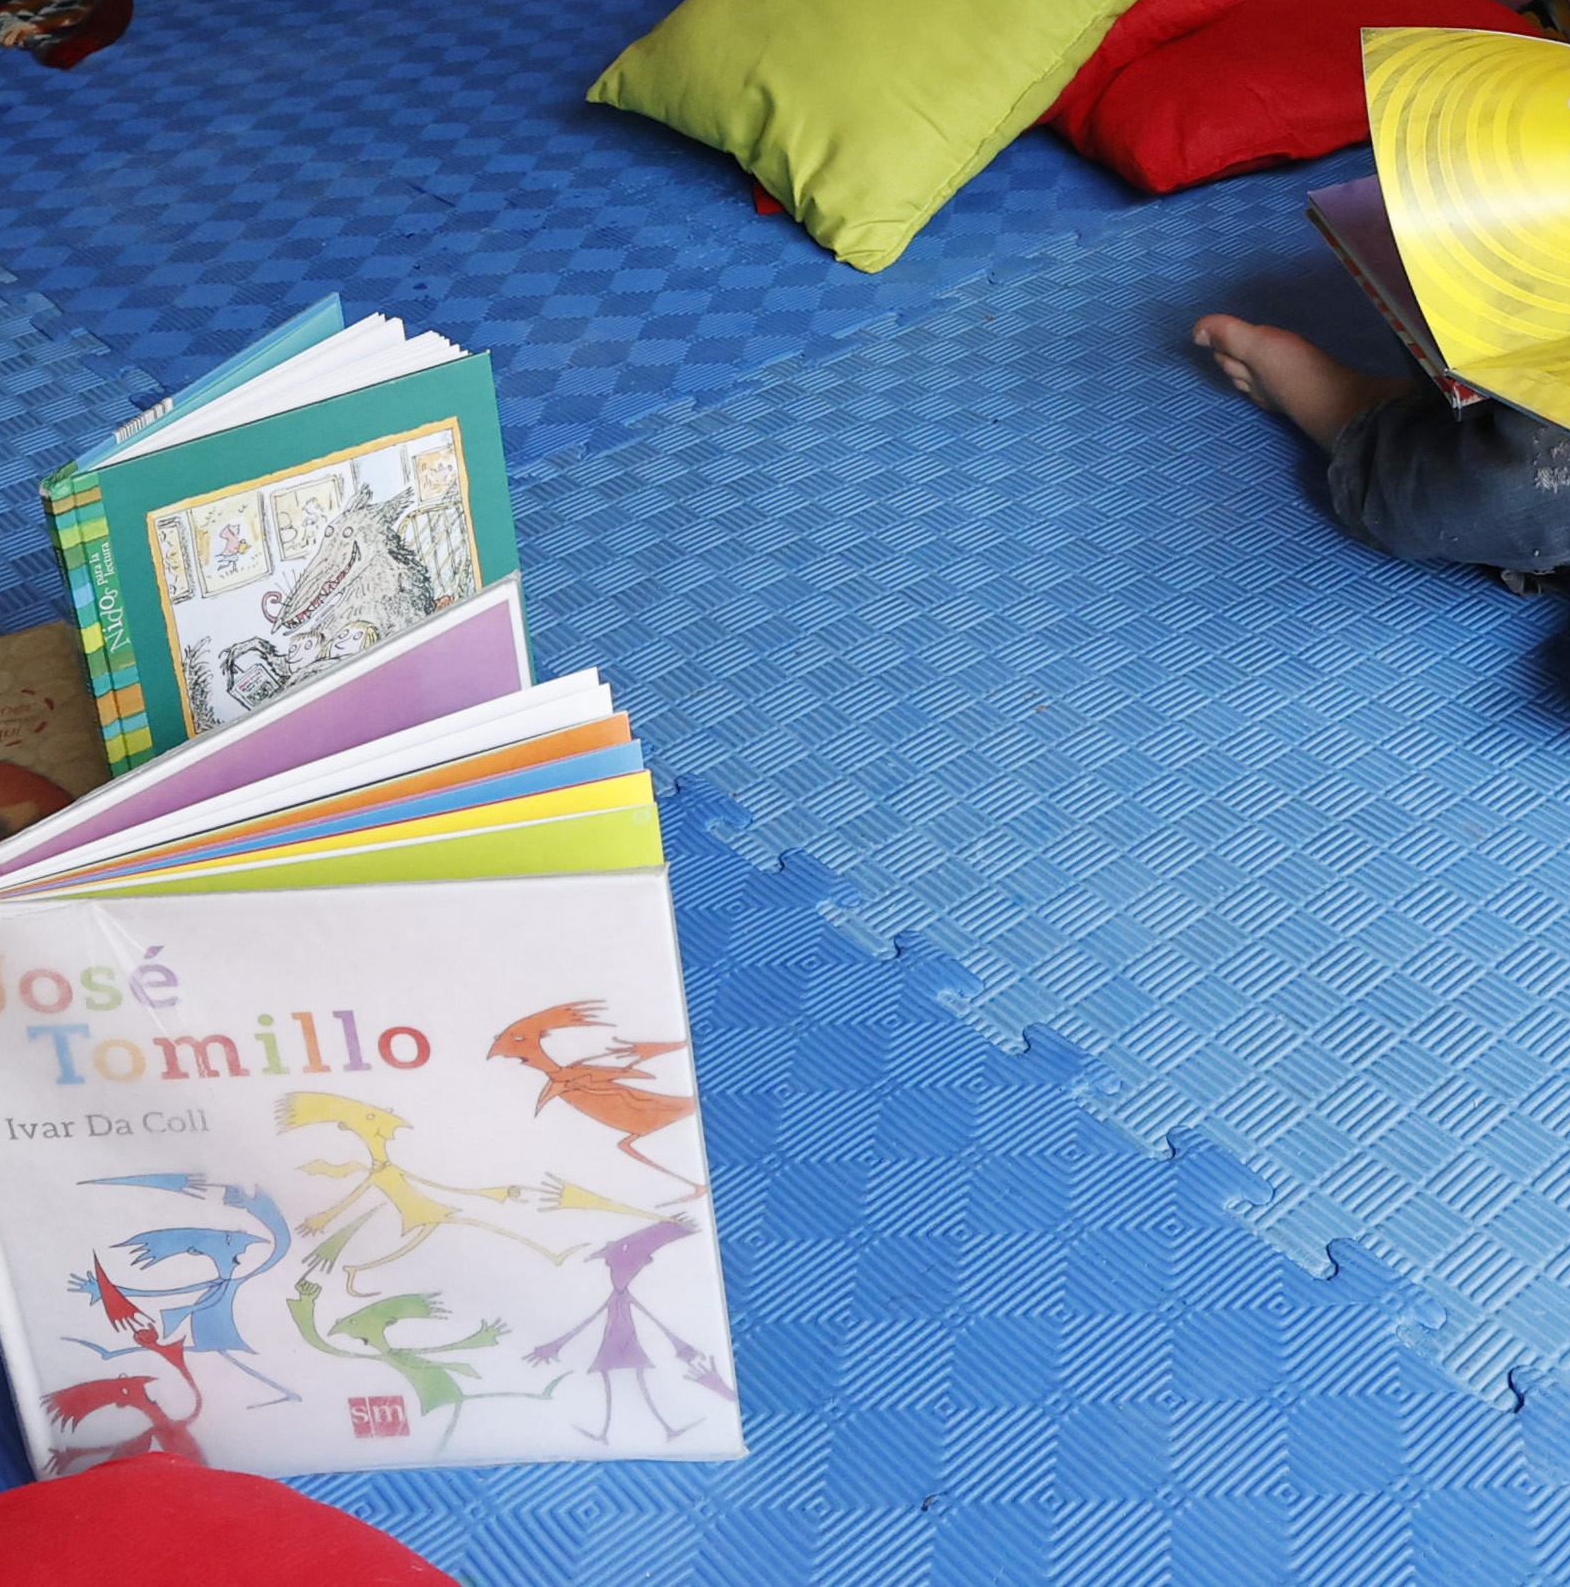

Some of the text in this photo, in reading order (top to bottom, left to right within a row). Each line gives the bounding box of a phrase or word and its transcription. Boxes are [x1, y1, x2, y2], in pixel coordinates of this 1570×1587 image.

[89, 552, 109, 587] para la
[101, 540, 116, 578] lectura
[28, 1008, 432, 1088] Tomillo
[4, 1110, 210, 1143] Ivar Da Coll
